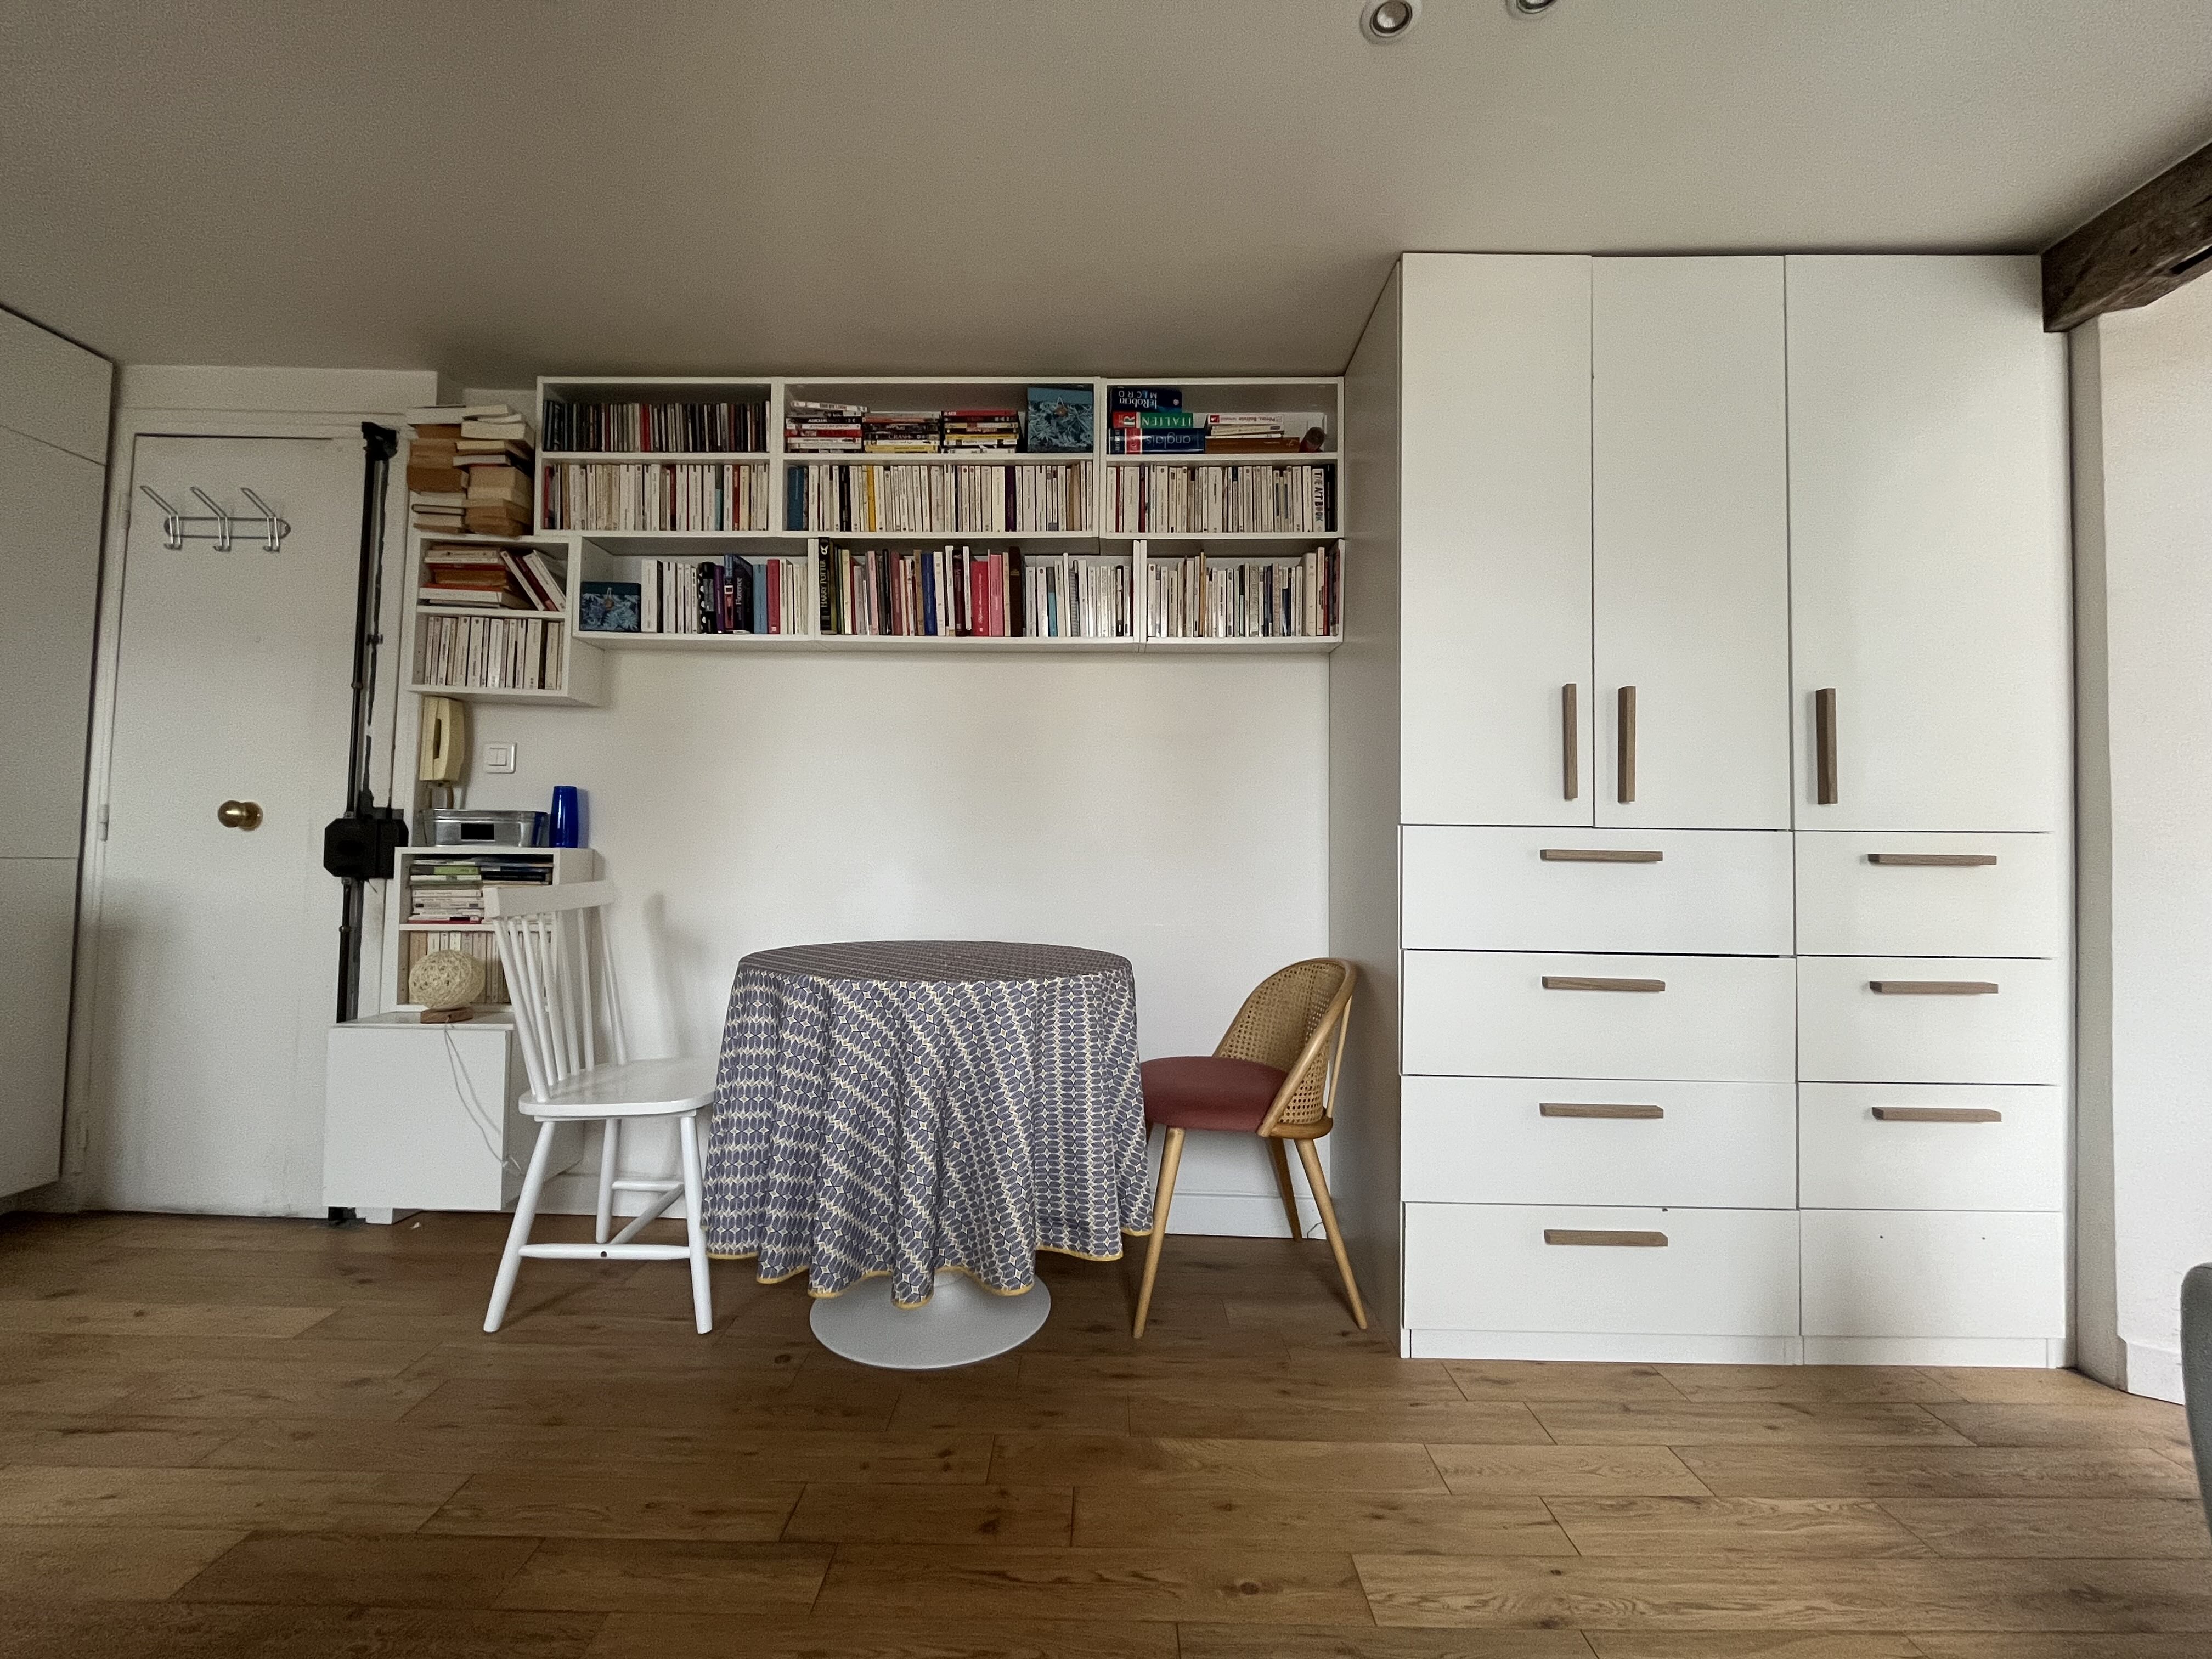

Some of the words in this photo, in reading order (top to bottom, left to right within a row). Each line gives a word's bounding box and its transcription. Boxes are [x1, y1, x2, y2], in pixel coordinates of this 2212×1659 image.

[1118, 390, 1158, 399] MICRO
[1141, 416, 1192, 426] ITALIEN
[1146, 432, 1191, 449] anglais
[820, 586, 828, 607] HARRY
